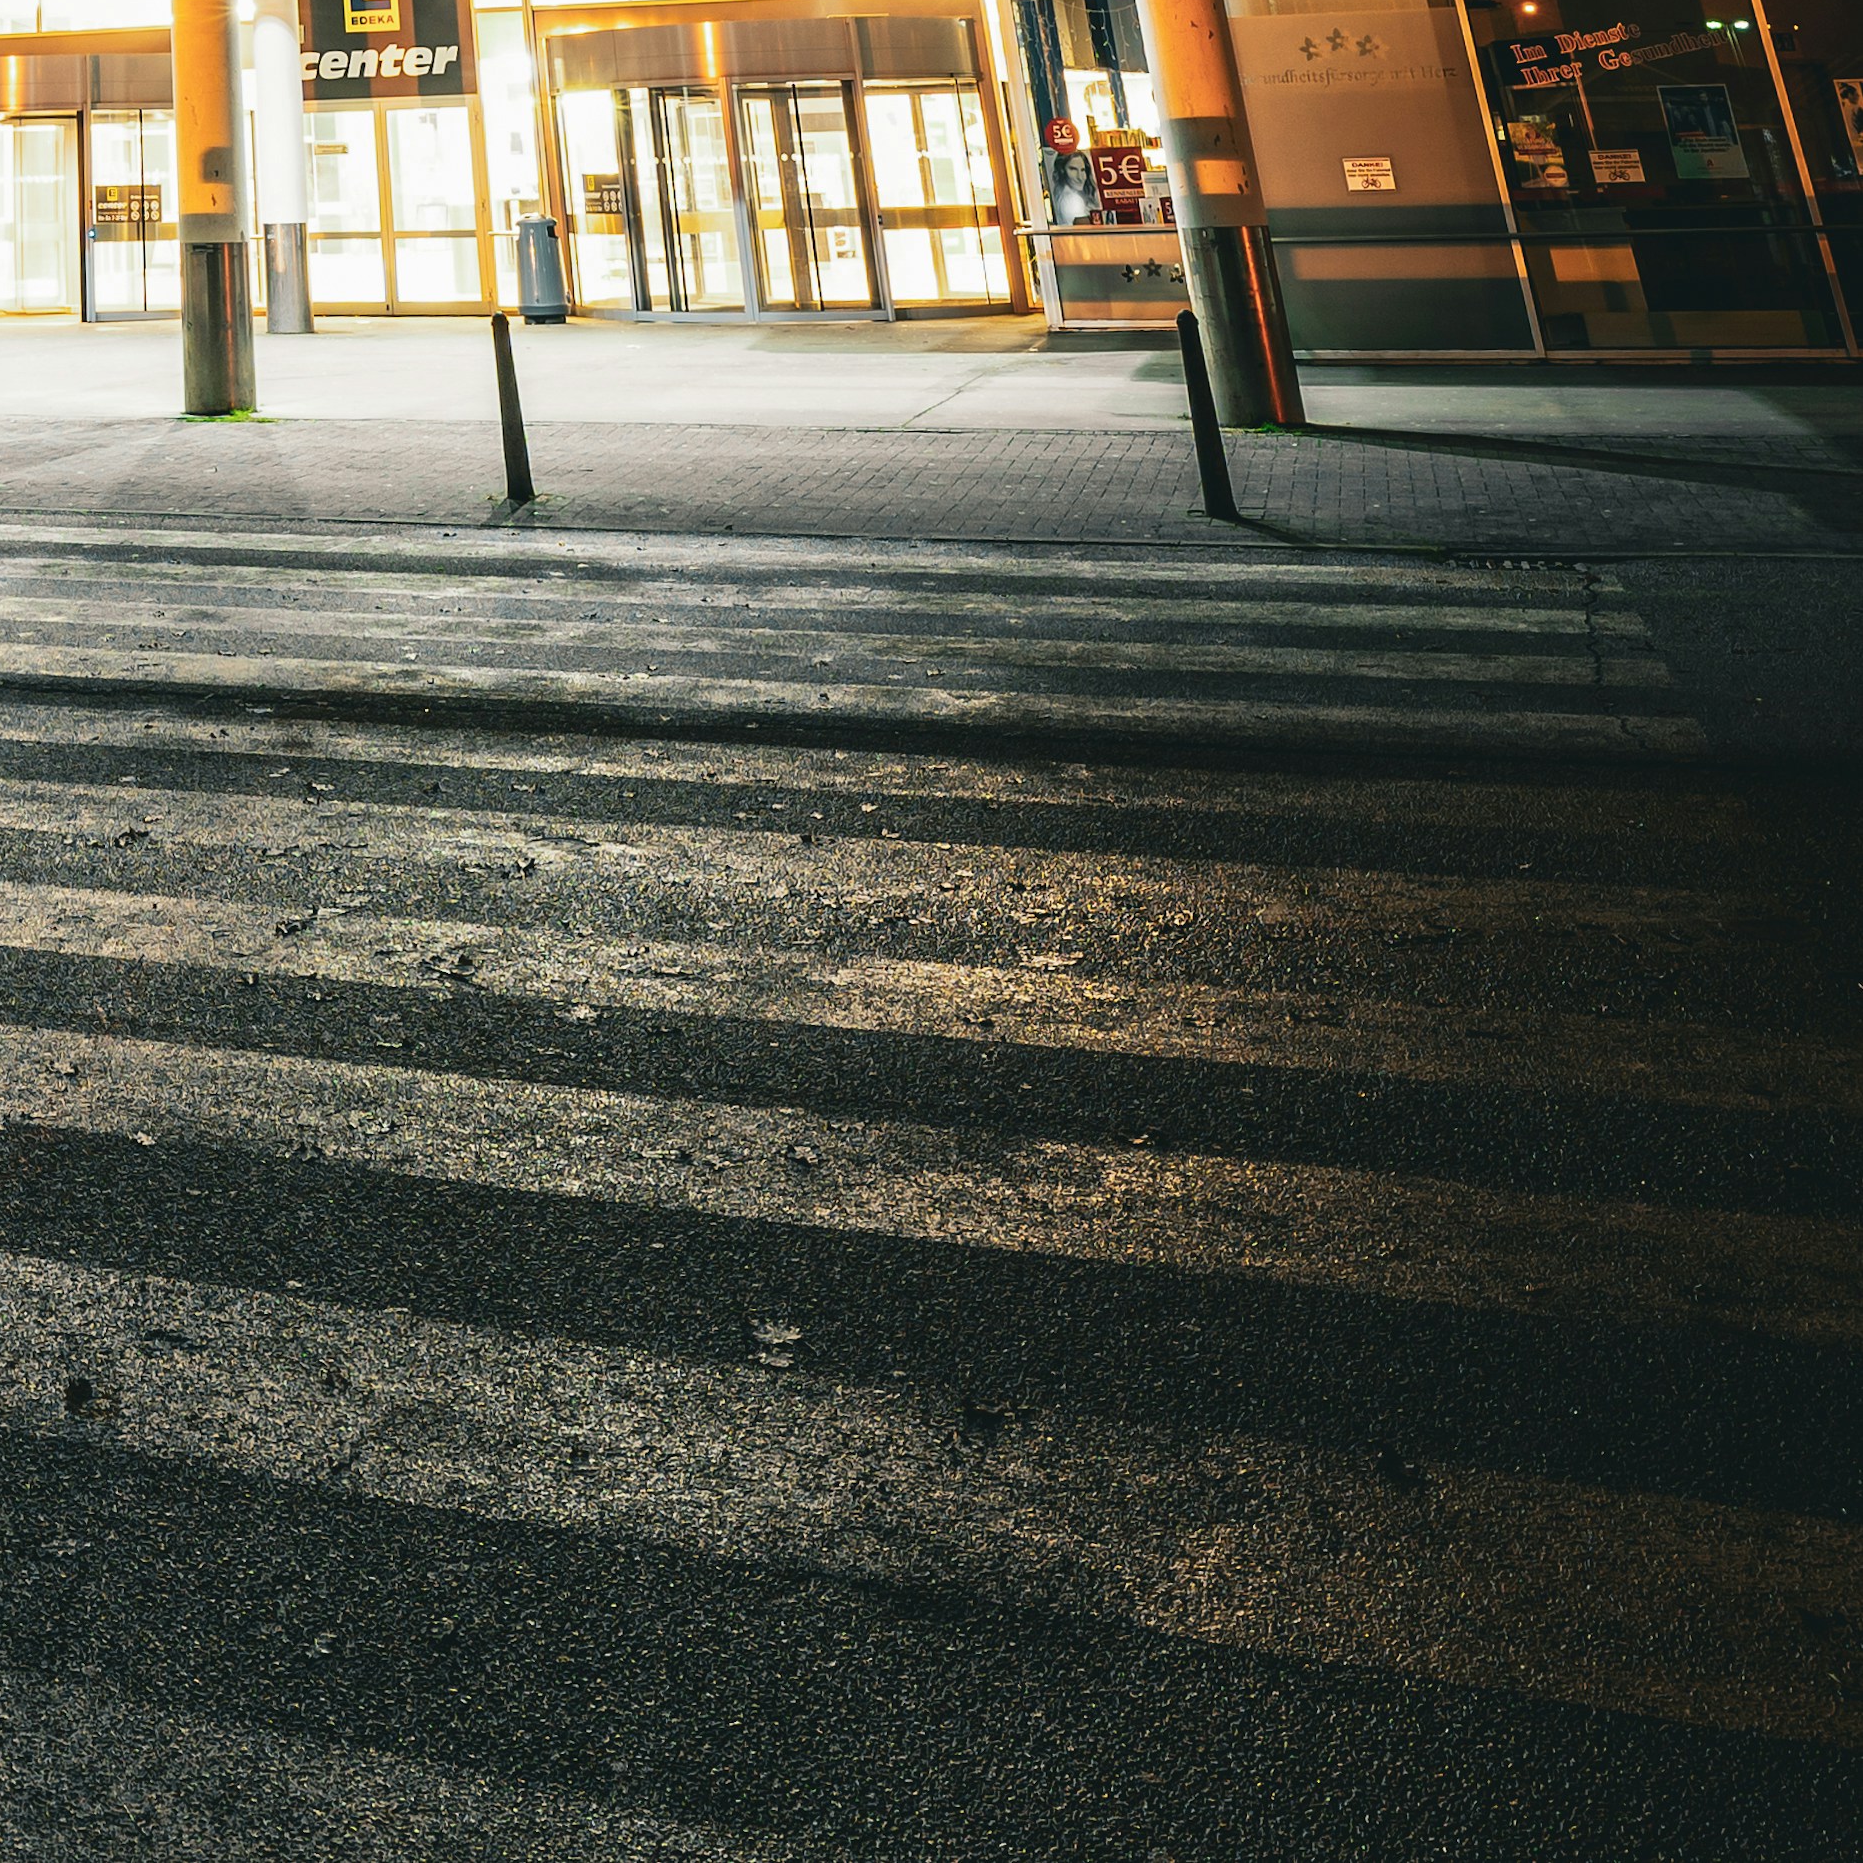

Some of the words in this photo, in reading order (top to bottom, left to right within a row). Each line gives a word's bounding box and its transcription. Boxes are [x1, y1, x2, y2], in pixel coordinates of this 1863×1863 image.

[351, 15, 395, 26] EDEKA
[1510, 43, 1547, 64] Im
[1554, 22, 1641, 55] Dienste
[1520, 61, 1582, 86] Ihrer
[1598, 29, 1729, 71] Gesundheit
[300, 43, 459, 81] center
[1052, 124, 1073, 140] 5€
[1098, 155, 1143, 186] 5€
